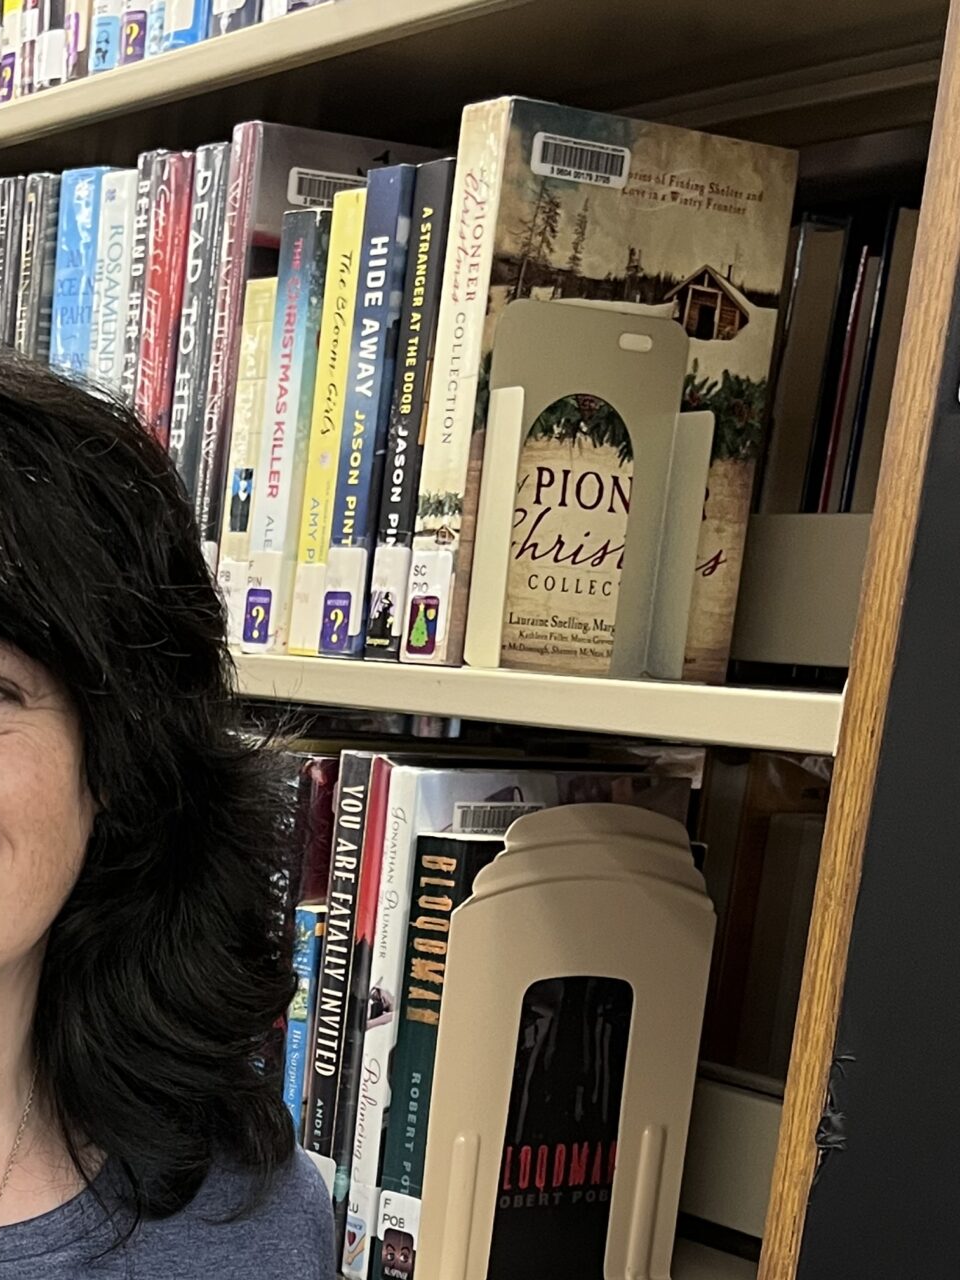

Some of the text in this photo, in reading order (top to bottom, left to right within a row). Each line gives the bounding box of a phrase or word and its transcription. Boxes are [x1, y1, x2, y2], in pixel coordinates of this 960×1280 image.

[668, 175, 705, 195] Finding
[708, 182, 744, 199] Shelter
[746, 190, 764, 202] and
[670, 191, 703, 210] Wintry
[706, 197, 747, 215] Frontier
[130, 180, 150, 277] BEHIND
[338, 250, 353, 290] The
[169, 167, 214, 450] DEAD TO HER
[327, 295, 349, 370] Bloom
[355, 236, 389, 398] HIDE AWAY
[399, 206, 434, 417] A STRANGER AT THE DOOR
[266, 237, 304, 499] THE CHRISTMAS KILLER
[441, 312, 466, 444] COLLECTION
[347, 410, 366, 485] JASON
[390, 426, 409, 503] JASON
[306, 497, 321, 541] AMY
[413, 564, 427, 577] SC
[413, 582, 429, 594] PIO
[527, 574, 621, 597] COLLEC
[509, 611, 549, 628] Lauraine
[550, 615, 591, 635] Snelling,
[378, 806, 408, 960] JONATHAN PLUMMER
[314, 784, 365, 1078] YOU ARE FATALLY INVITED
[312, 1098, 325, 1137] ANDE
[353, 1057, 381, 1161] Balancing
[404, 1072, 422, 1152] ROBERT
[382, 1214, 405, 1229] POB
[383, 1199, 391, 1209] F
[499, 1189, 609, 1209] OBERT POB
